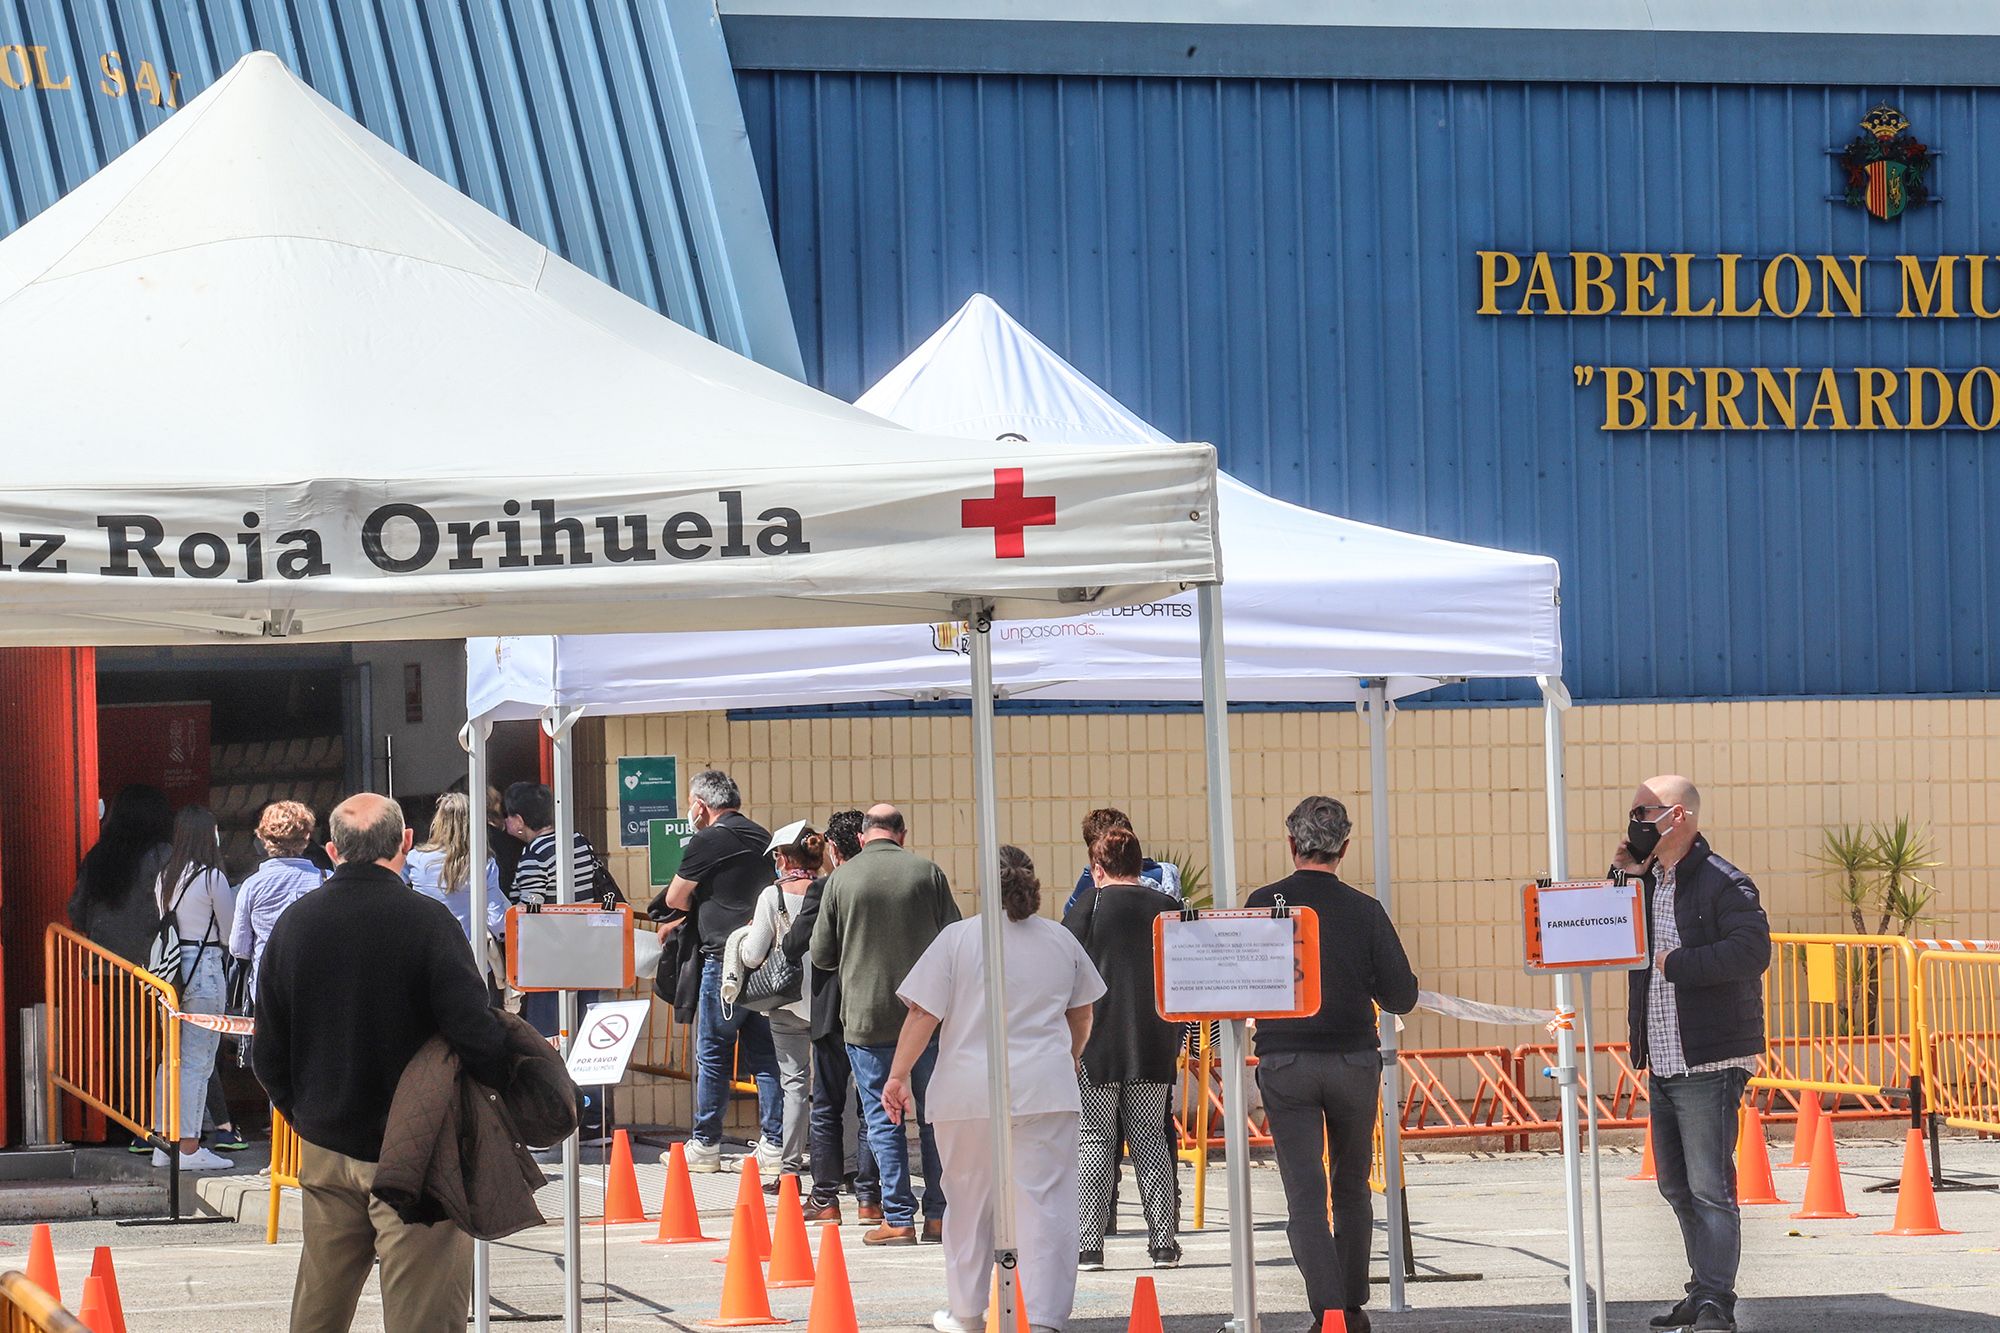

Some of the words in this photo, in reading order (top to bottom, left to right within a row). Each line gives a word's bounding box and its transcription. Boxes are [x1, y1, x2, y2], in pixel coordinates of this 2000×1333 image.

[1475, 251, 1868, 318] PABELLON
[1895, 254, 2000, 319] MU
[0, 532, 68, 574] z
[96, 511, 331, 583] Roja
[361, 491, 811, 573] Orihuela
[1547, 916, 1628, 929] FARMACÉUTICOS/AS
